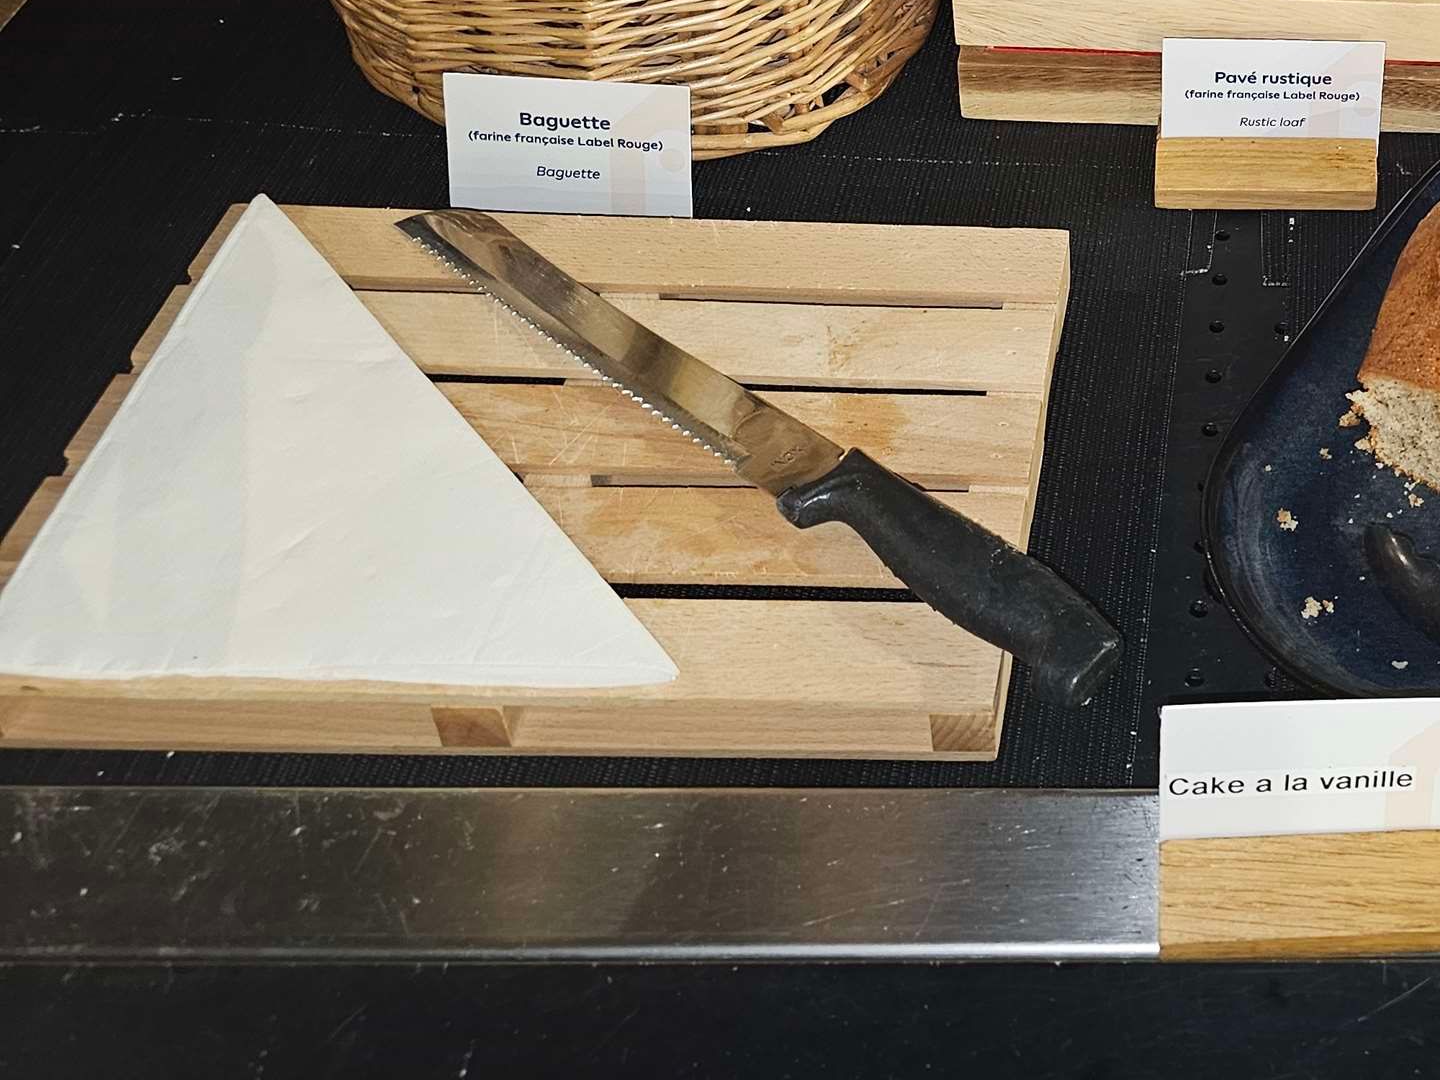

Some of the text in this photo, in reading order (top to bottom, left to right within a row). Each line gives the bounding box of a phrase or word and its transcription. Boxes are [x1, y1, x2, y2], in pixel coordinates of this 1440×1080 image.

[1214, 71, 1333, 88] Pavé rustique
[1184, 90, 1361, 103] (farine française Label Rouge)
[519, 112, 611, 131] Baguette
[1239, 116, 1307, 128] Rustic loaf
[467, 130, 664, 152] (farine française Label Rouge)
[536, 165, 601, 181] Baguette
[1168, 770, 1414, 796] Cake a la vanille
